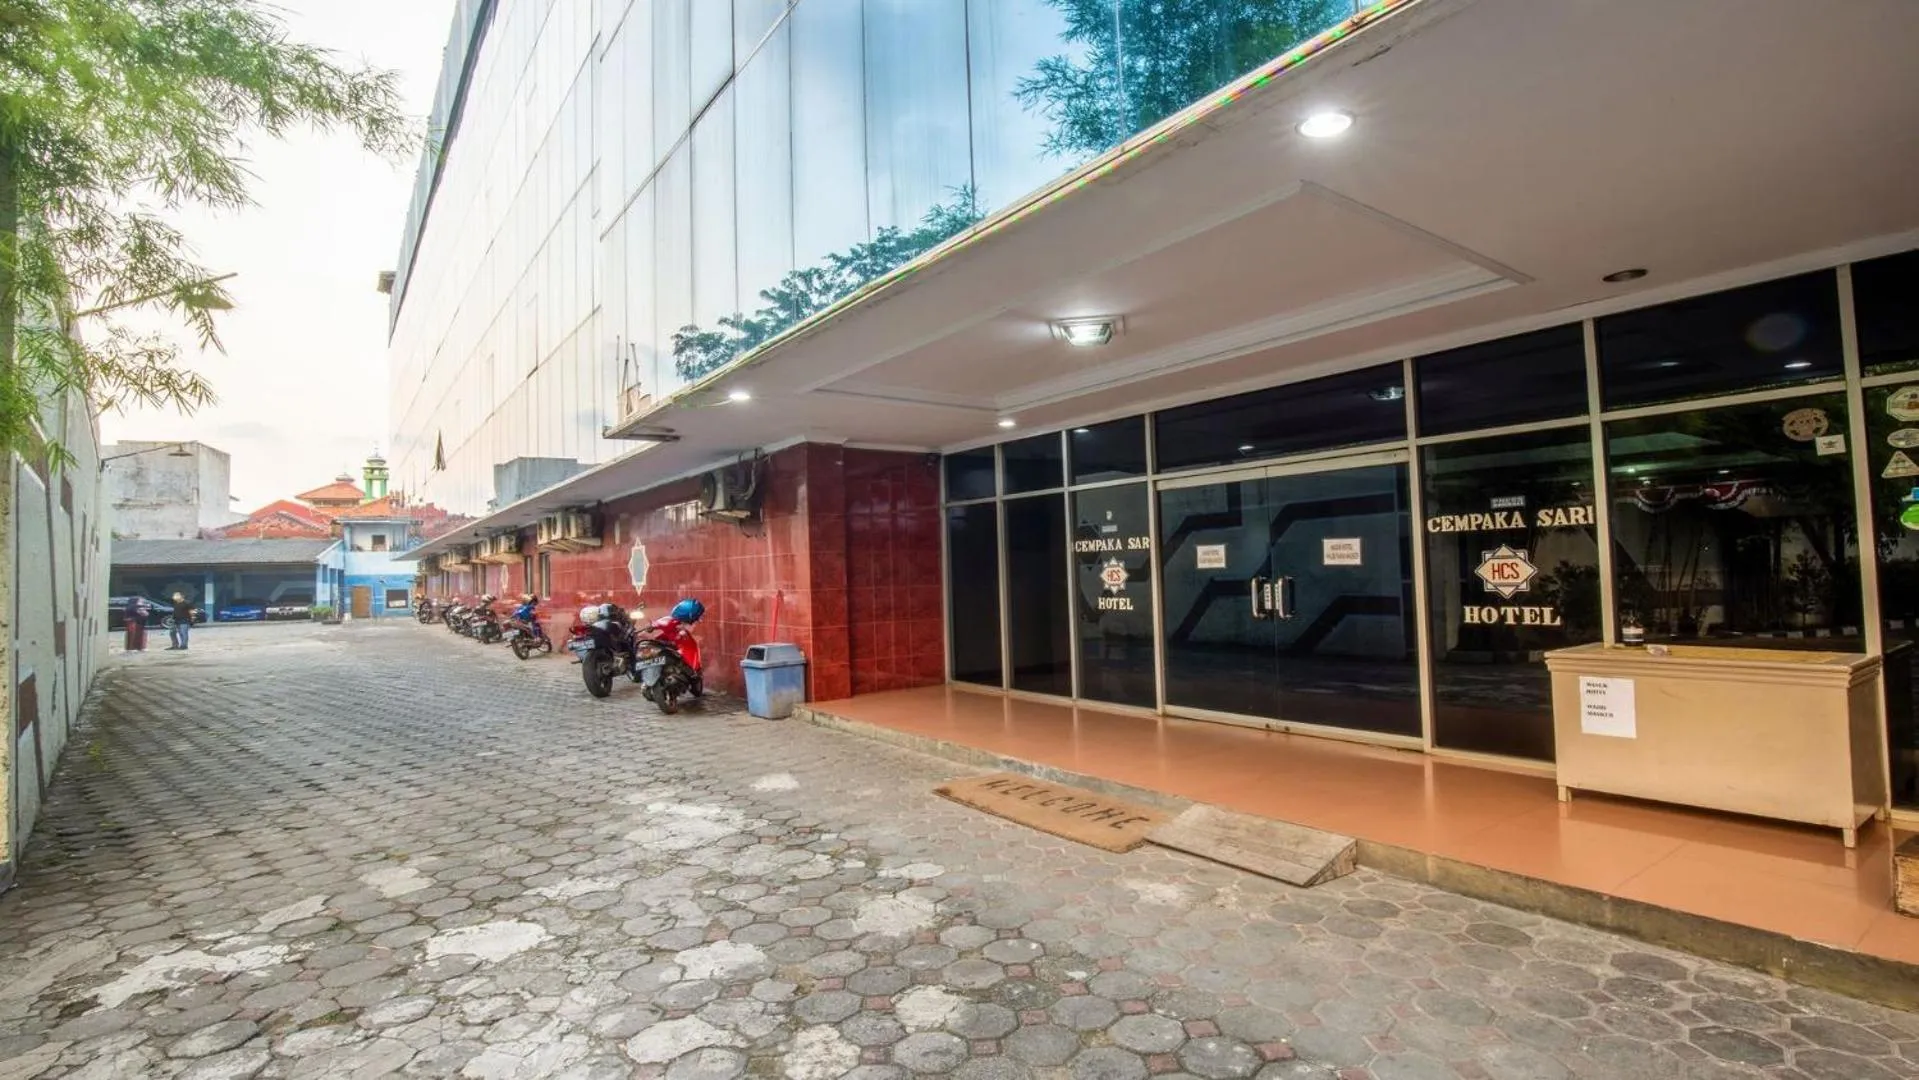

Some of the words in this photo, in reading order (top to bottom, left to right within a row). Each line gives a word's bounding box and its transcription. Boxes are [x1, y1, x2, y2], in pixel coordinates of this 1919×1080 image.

[1427, 510, 1526, 533] CEMPAKA
[1537, 505, 1595, 527] SARI
[1075, 538, 1123, 552] CEMPAKA
[1127, 536, 1150, 550] SAR
[1107, 569, 1121, 582] HCS
[1491, 562, 1520, 580] HCS
[1098, 597, 1133, 610] HOTEL
[1463, 605, 1562, 626] HOTEL
[979, 778, 1151, 830] WELCOME
